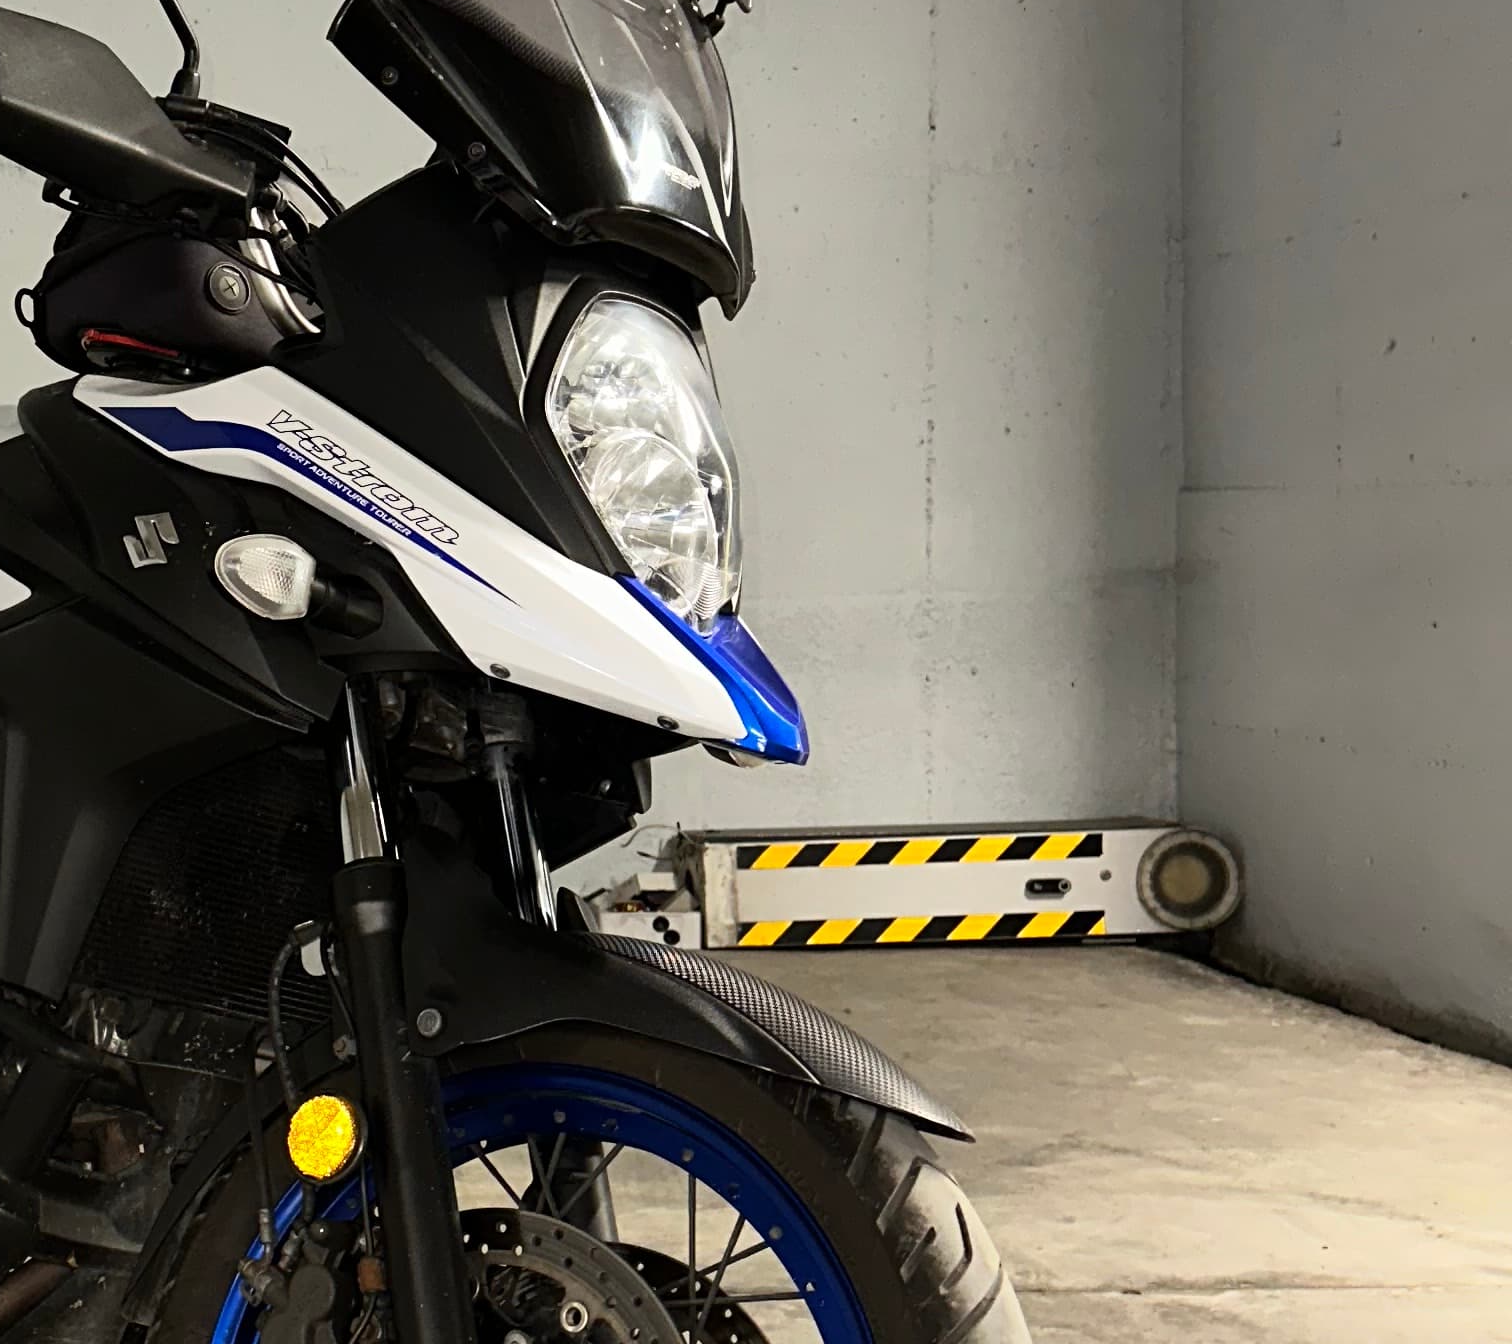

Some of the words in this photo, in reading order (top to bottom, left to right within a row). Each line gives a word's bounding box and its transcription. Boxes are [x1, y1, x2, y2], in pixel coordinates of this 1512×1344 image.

[267, 409, 459, 545] V-Strom
[276, 442, 310, 466] SPORT
[309, 465, 368, 507] ADVENTURE
[369, 505, 412, 537] TOURER
